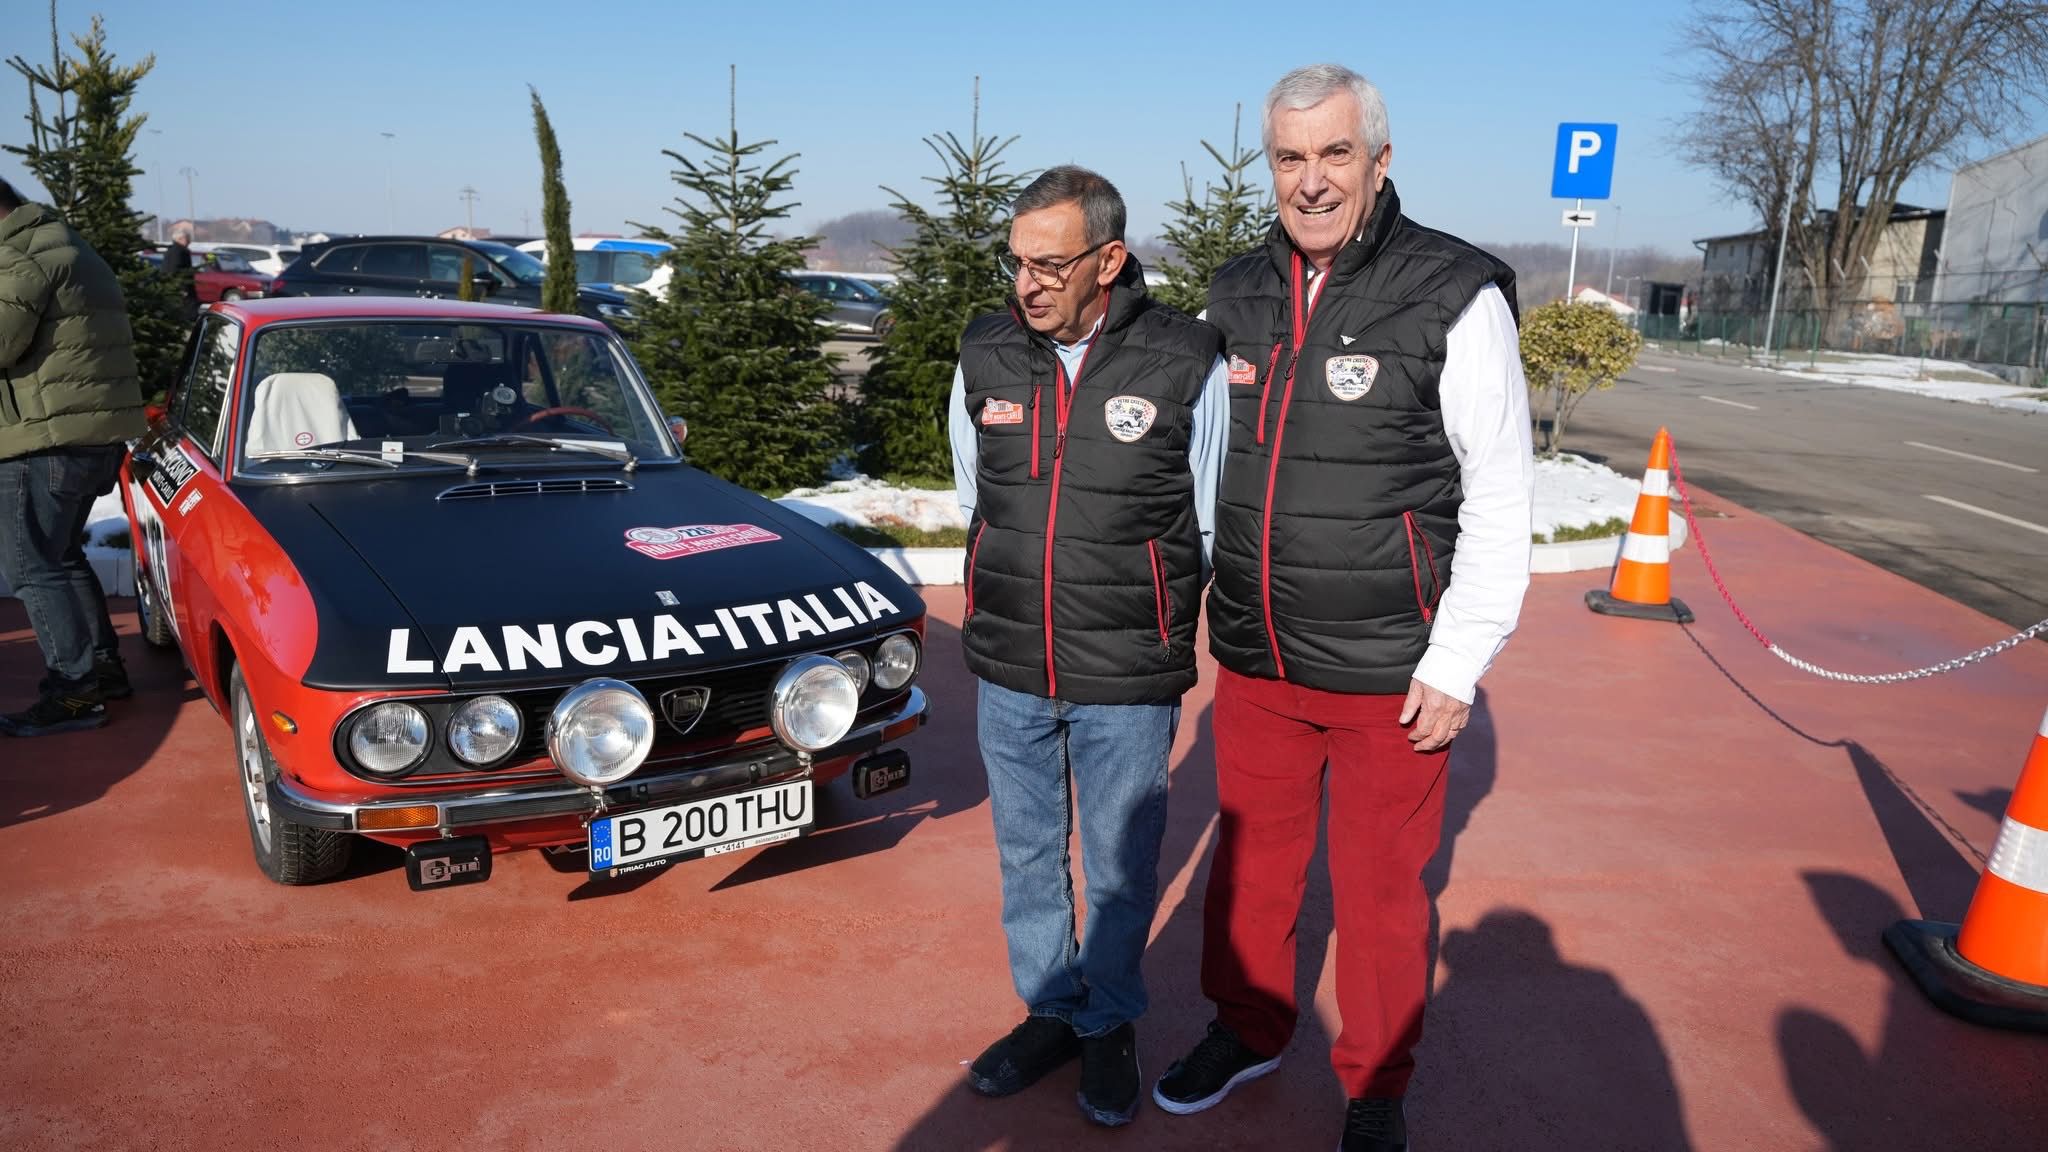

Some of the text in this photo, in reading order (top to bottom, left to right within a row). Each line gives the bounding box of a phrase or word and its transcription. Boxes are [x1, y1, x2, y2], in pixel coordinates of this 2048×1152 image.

[1568, 130, 1602, 174] P
[386, 580, 901, 673] LANCIA-ITALIA
[619, 786, 806, 857] B 200 THU
[594, 846, 611, 864] RO
[619, 858, 667, 875] TIRIAC AUTO
